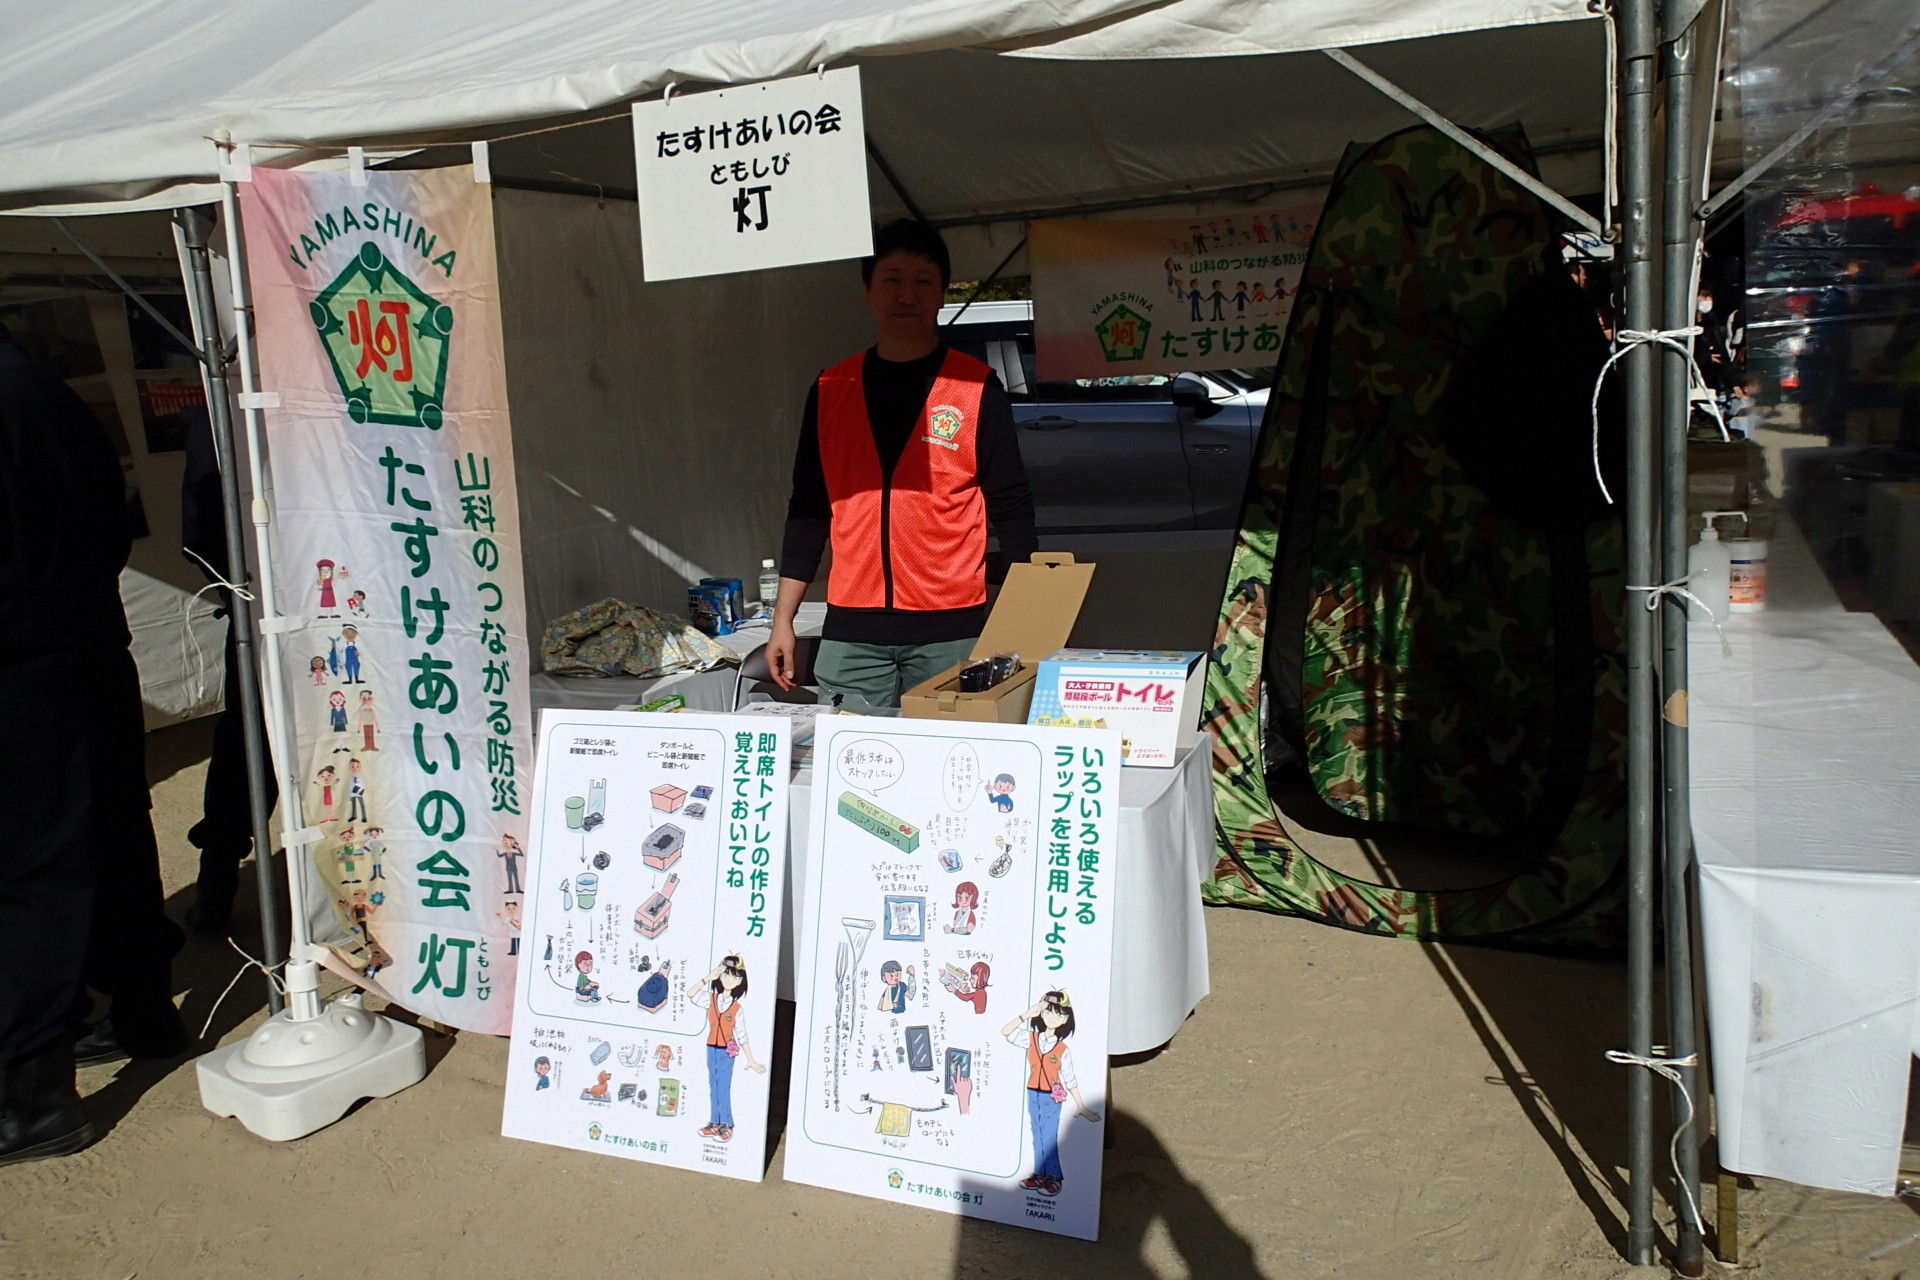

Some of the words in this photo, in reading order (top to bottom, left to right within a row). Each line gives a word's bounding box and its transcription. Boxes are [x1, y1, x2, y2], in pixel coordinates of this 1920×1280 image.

[656, 103, 842, 158] たすけあいの会
[710, 152, 791, 185] ともしび
[732, 184, 772, 233] 灯
[289, 202, 457, 278] YAMASHINA
[1090, 291, 1154, 317] YAMASHINA
[347, 298, 414, 383] 灯
[1161, 322, 1282, 359] たすけあ
[454, 452, 522, 816] 山科のつながる防災
[378, 446, 472, 912] たすけあいの会
[1116, 682, 1175, 703] トイレ
[659, 741, 695, 750] ダンボールと
[661, 762, 690, 770] 即席トイレ
[848, 767, 896, 779] ストックしたい
[726, 731, 753, 888] 覚えておいてね
[746, 732, 777, 937] 即席トイレの作り方
[1074, 746, 1104, 925] いろいろ使える
[1044, 745, 1074, 971] ラップを活用しよう
[411, 933, 476, 999] 灯
[477, 936, 492, 1001] ともしび
[604, 1133, 657, 1151] たすけあいの会
[906, 1181, 970, 1206] たすけあいの会
